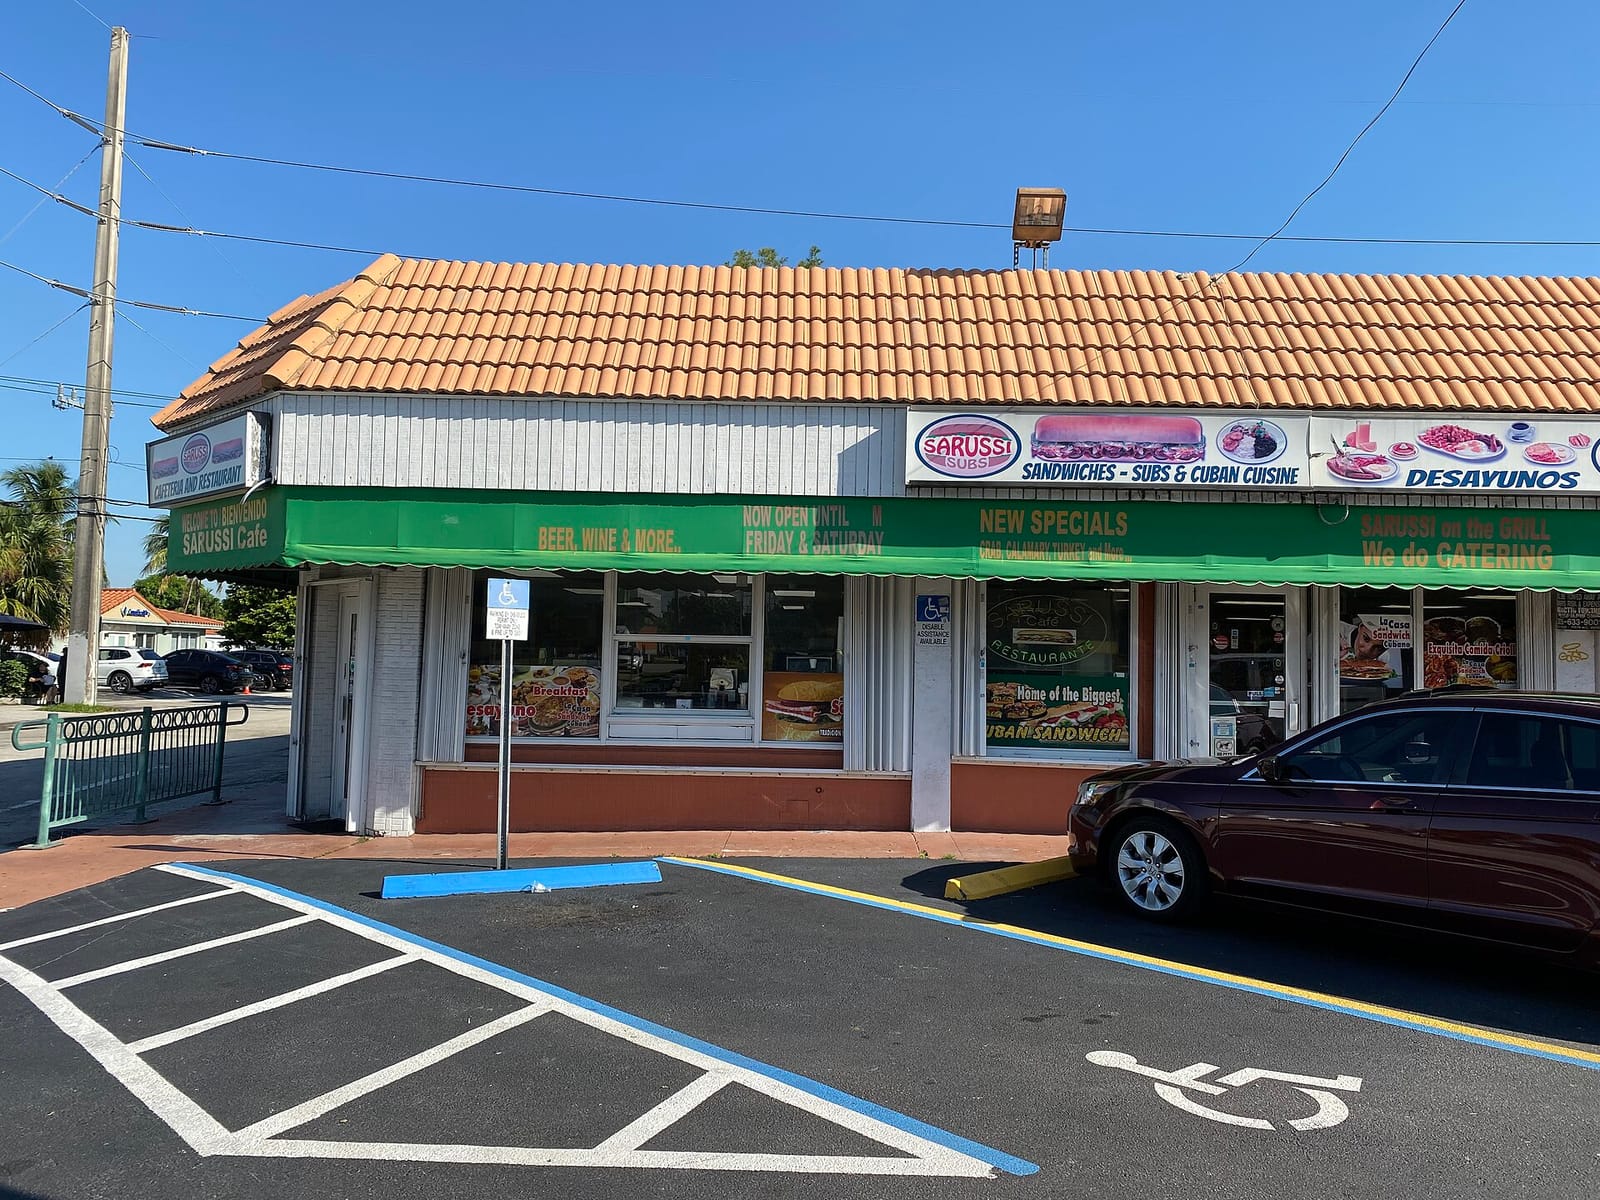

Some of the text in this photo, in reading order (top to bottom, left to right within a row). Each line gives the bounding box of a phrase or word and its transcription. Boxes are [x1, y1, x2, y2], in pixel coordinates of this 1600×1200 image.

[924, 434, 1012, 459] SARUSSI
[945, 456, 990, 470] SUBS
[1022, 462, 1116, 481] SANDWICHES
[1132, 464, 1170, 482] SUBS
[1174, 465, 1185, 482] &
[1191, 465, 1240, 484] CUBAN
[1243, 466, 1299, 485] CUISINE
[154, 478, 183, 500] CAFETERIA
[184, 475, 198, 493] AND
[198, 464, 242, 491] RESTAURANT
[1405, 469, 1581, 489] DESAYUNOS
[182, 511, 209, 533] WELCOME
[209, 509, 218, 529] TO
[222, 498, 267, 526] BIENVENIDO
[743, 505, 772, 528] NOW
[775, 506, 808, 528] OPEN
[812, 505, 850, 527] UNTIL
[980, 509, 1128, 536] NEW SPECIALS
[1361, 514, 1551, 541] SARUSSI on the GRILL
[183, 523, 268, 556] SARUSSI Cafe
[582, 528, 617, 552] WINE
[620, 528, 630, 552] &
[746, 530, 884, 555] FRIDAY & SATURDAY
[1052, 542, 1086, 560] TURKEY
[1362, 540, 1553, 570] We do CATERING
[1380, 616, 1410, 629] La Casa
[1373, 630, 1410, 640] Sandwich
[1384, 640, 1411, 648] Cubano
[990, 639, 1095, 663] RESTAURANTE
[1427, 641, 1517, 657] Exquisita Comida Crioll
[533, 686, 590, 697] Breakfast
[1017, 684, 1121, 706] Home of the Biggest
[467, 704, 536, 720] esayno
[986, 725, 1123, 743] UBAN SANDWICH
